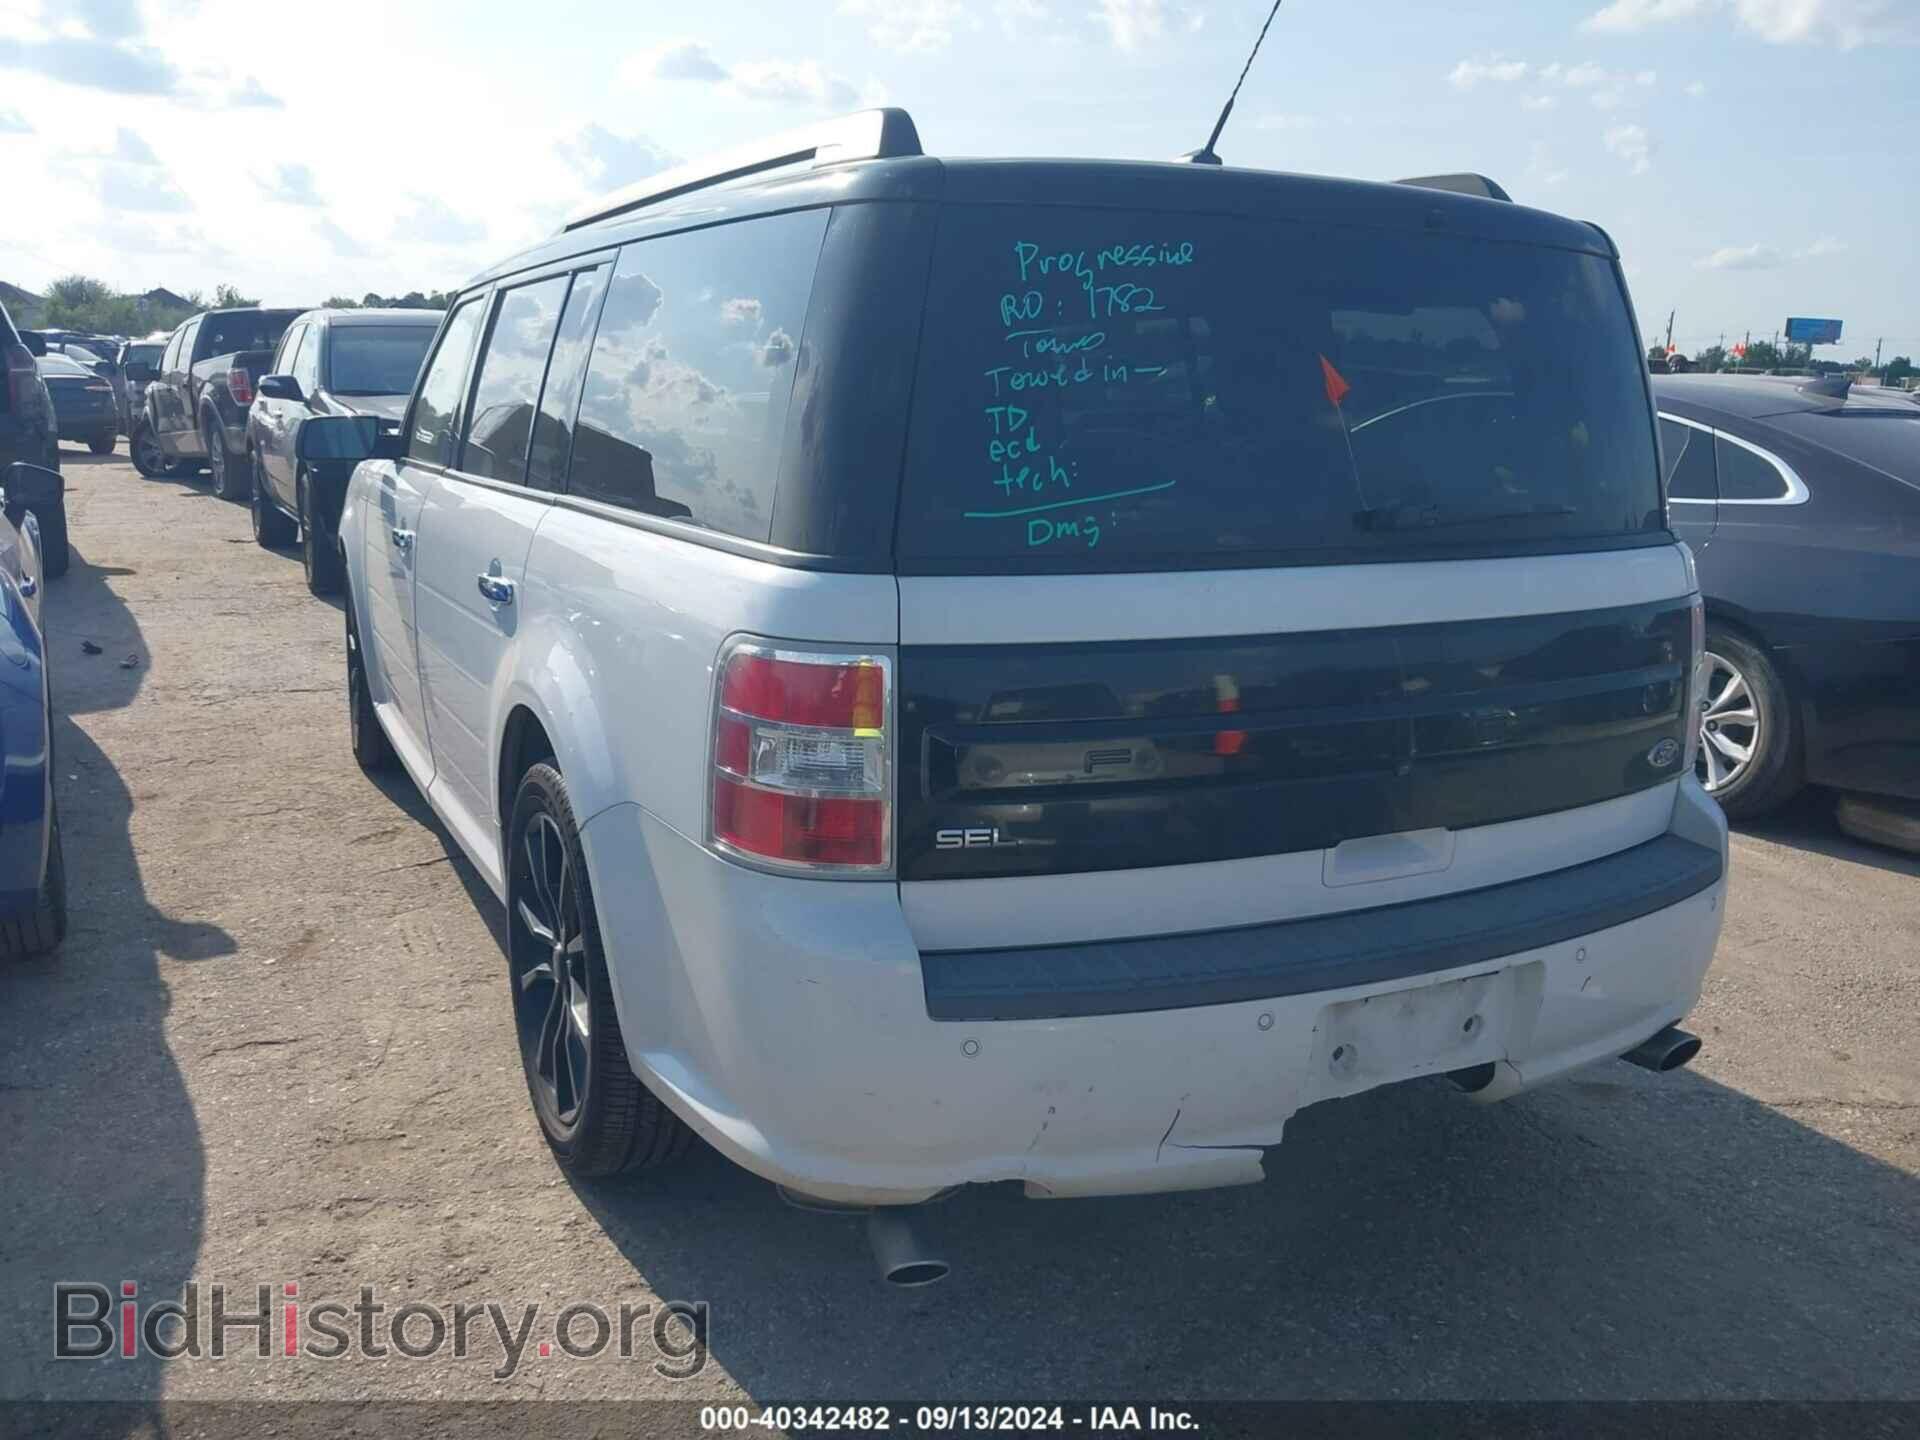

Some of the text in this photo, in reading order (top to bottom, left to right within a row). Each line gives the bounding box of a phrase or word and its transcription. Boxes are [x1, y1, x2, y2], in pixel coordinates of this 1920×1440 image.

[1014, 241, 1193, 290] Progressive
[985, 355, 1128, 397] Towed in
[985, 405, 1028, 434] TD
[935, 827, 1017, 849] SEL
